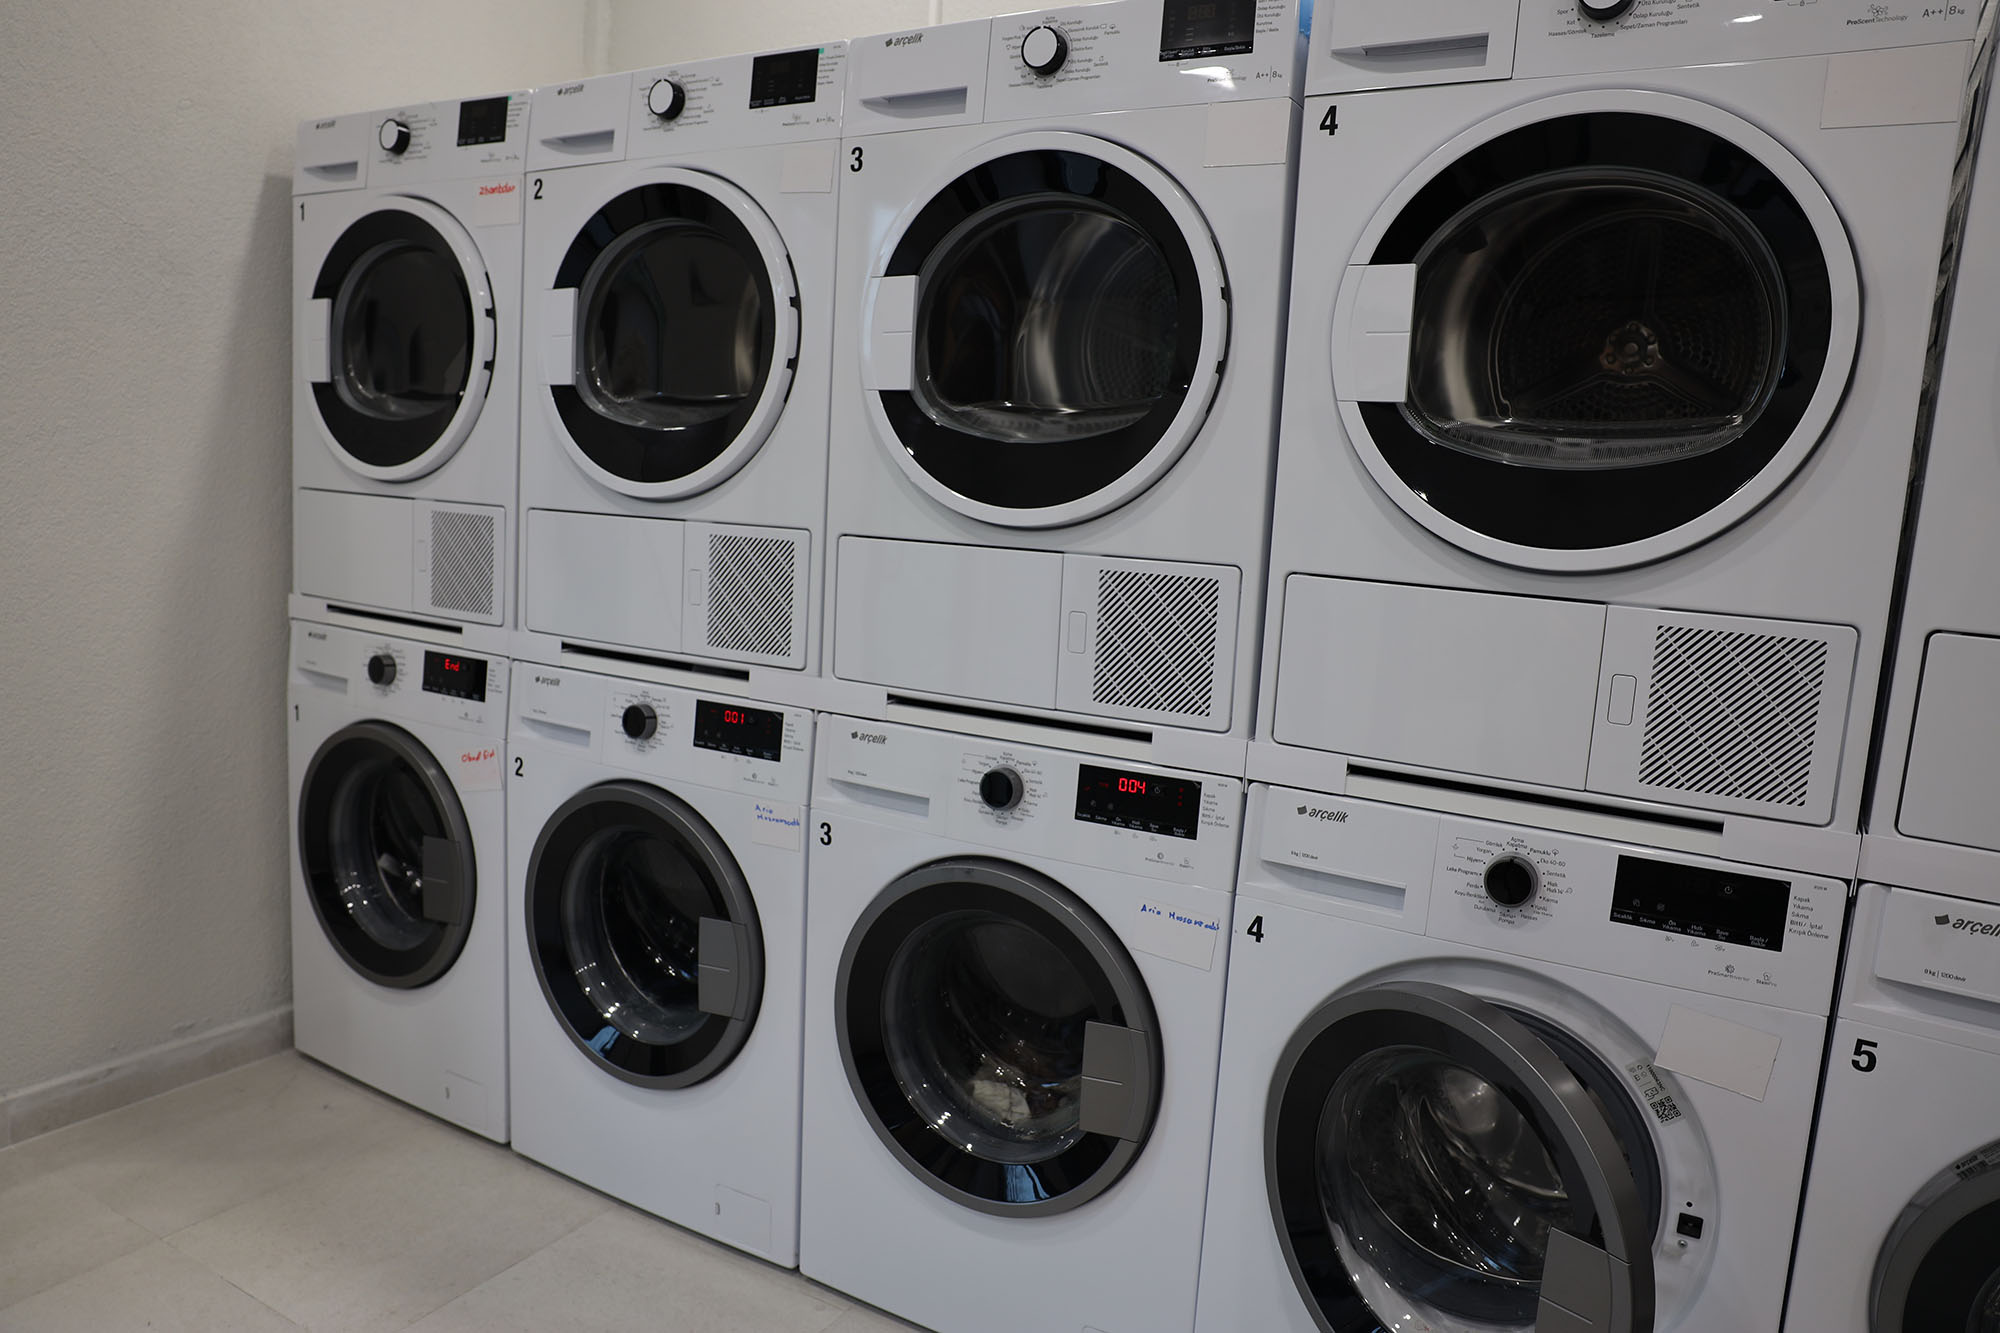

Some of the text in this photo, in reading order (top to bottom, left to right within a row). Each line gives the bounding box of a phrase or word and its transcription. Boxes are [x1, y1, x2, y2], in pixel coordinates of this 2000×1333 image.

[894, 33, 923, 47] arçelik
[1320, 105, 1339, 136] 4
[851, 147, 863, 172] 3
[533, 178, 543, 200] 2
[300, 202, 305, 221] 1
[445, 658, 460, 672] End
[295, 704, 299, 721] 1
[724, 710, 745, 725] 001
[859, 732, 888, 745] arçelik
[515, 757, 524, 777] 2
[1118, 777, 1146, 795] 004
[1309, 808, 1349, 823] arçelik
[820, 822, 832, 846] 3
[1247, 915, 1264, 943] 4
[1851, 1038, 1878, 1073] 5
